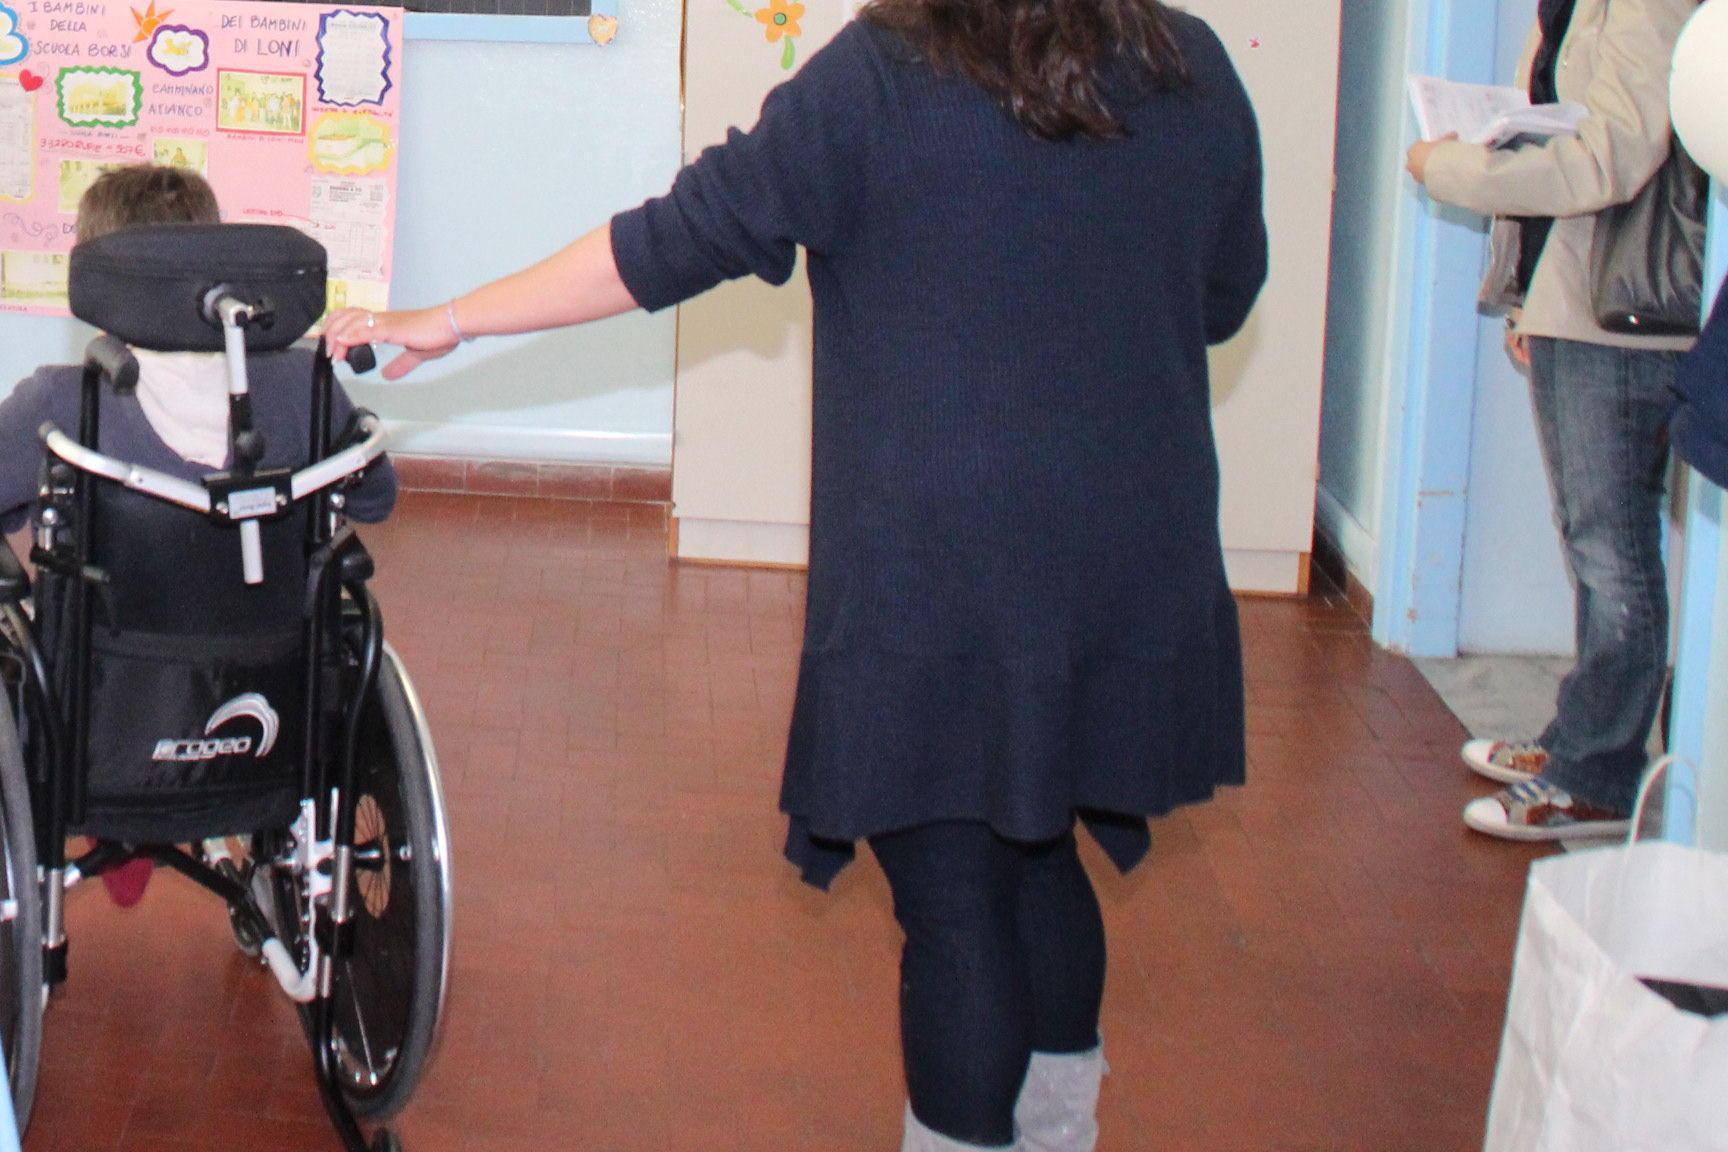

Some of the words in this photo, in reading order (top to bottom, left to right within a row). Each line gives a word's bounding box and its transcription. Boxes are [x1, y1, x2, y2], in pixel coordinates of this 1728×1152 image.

[29, 0, 39, 13] I
[43, 1, 106, 17] BAMBINI
[50, 19, 87, 33] DELLA
[221, 14, 242, 29] DEI
[250, 14, 307, 30] BAMBINI
[33, 40, 81, 56] SCUOLA
[234, 38, 248, 53] DI
[257, 39, 301, 58] LONI
